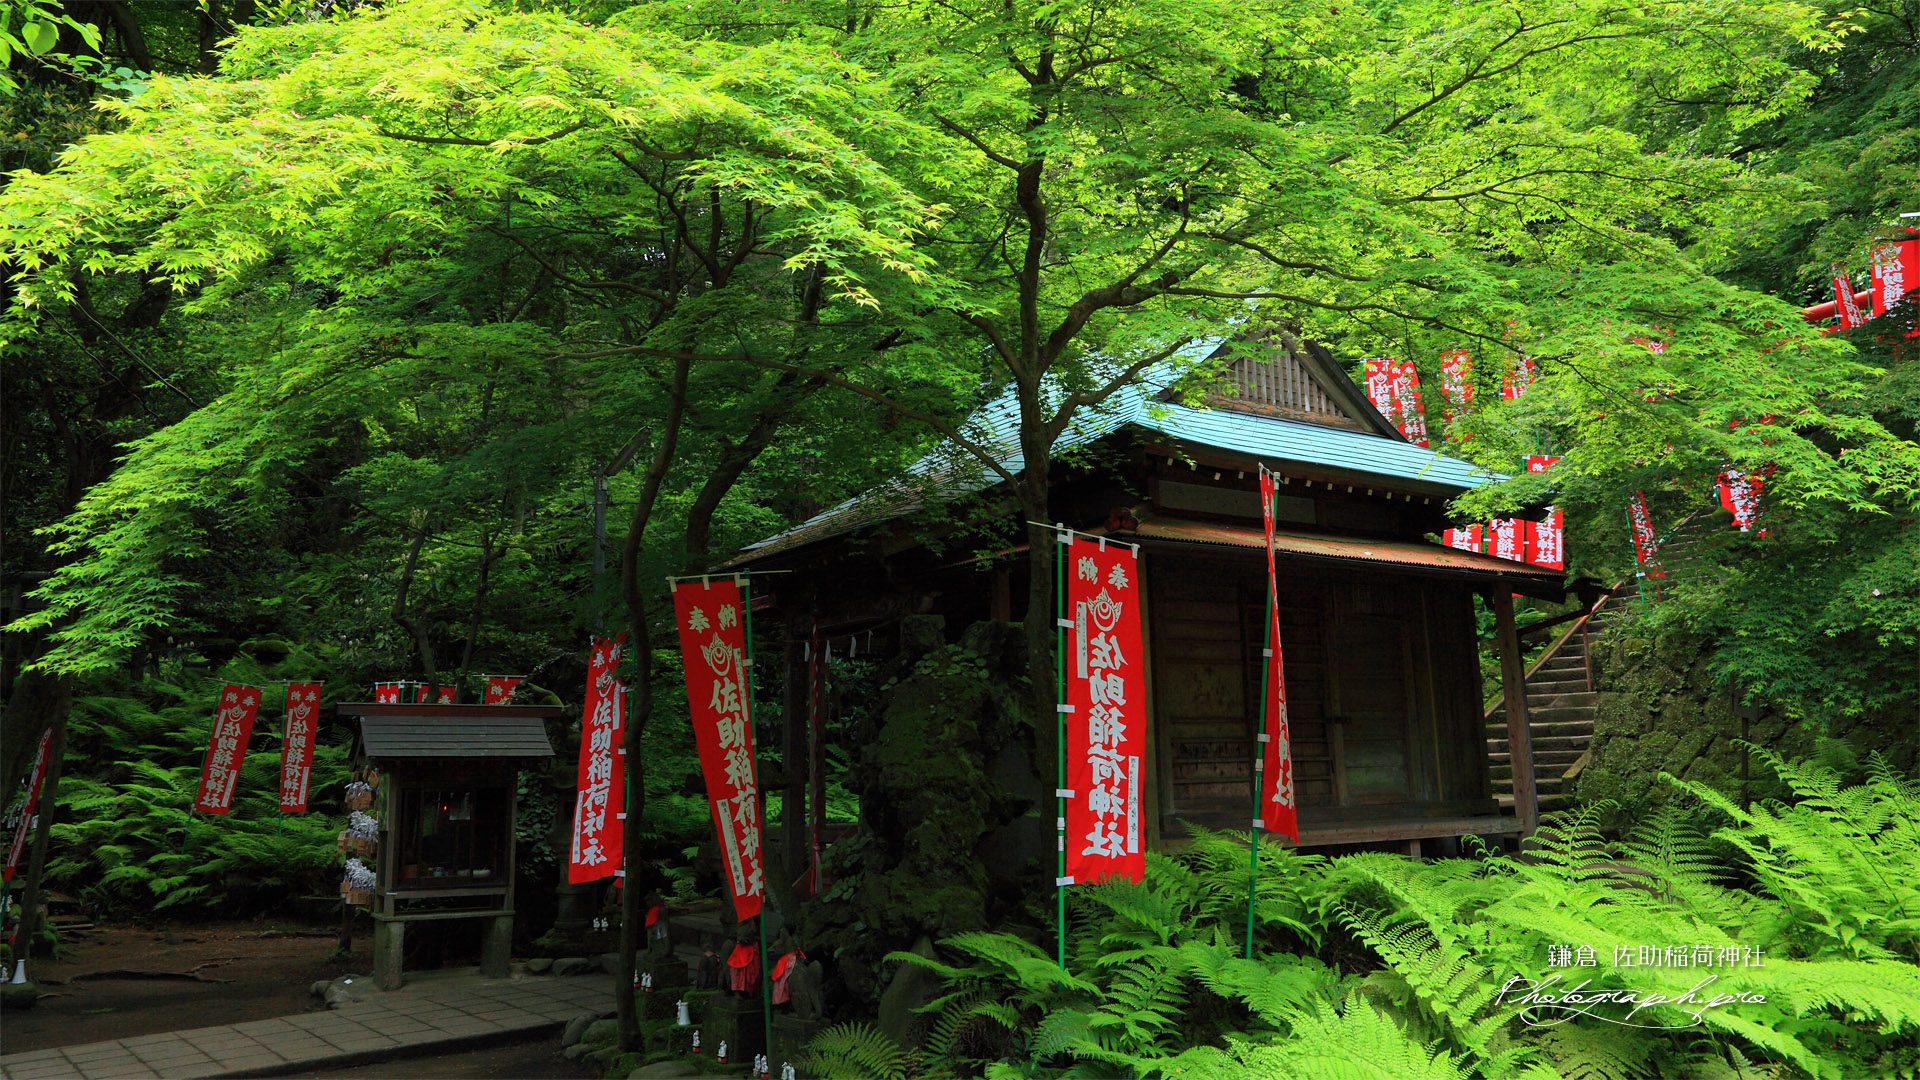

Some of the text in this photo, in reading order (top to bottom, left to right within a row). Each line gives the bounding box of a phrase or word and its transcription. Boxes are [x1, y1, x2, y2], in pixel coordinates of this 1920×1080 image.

[688, 604, 738, 634] 奉納
[580, 697, 612, 867] 佐助稲荷神社
